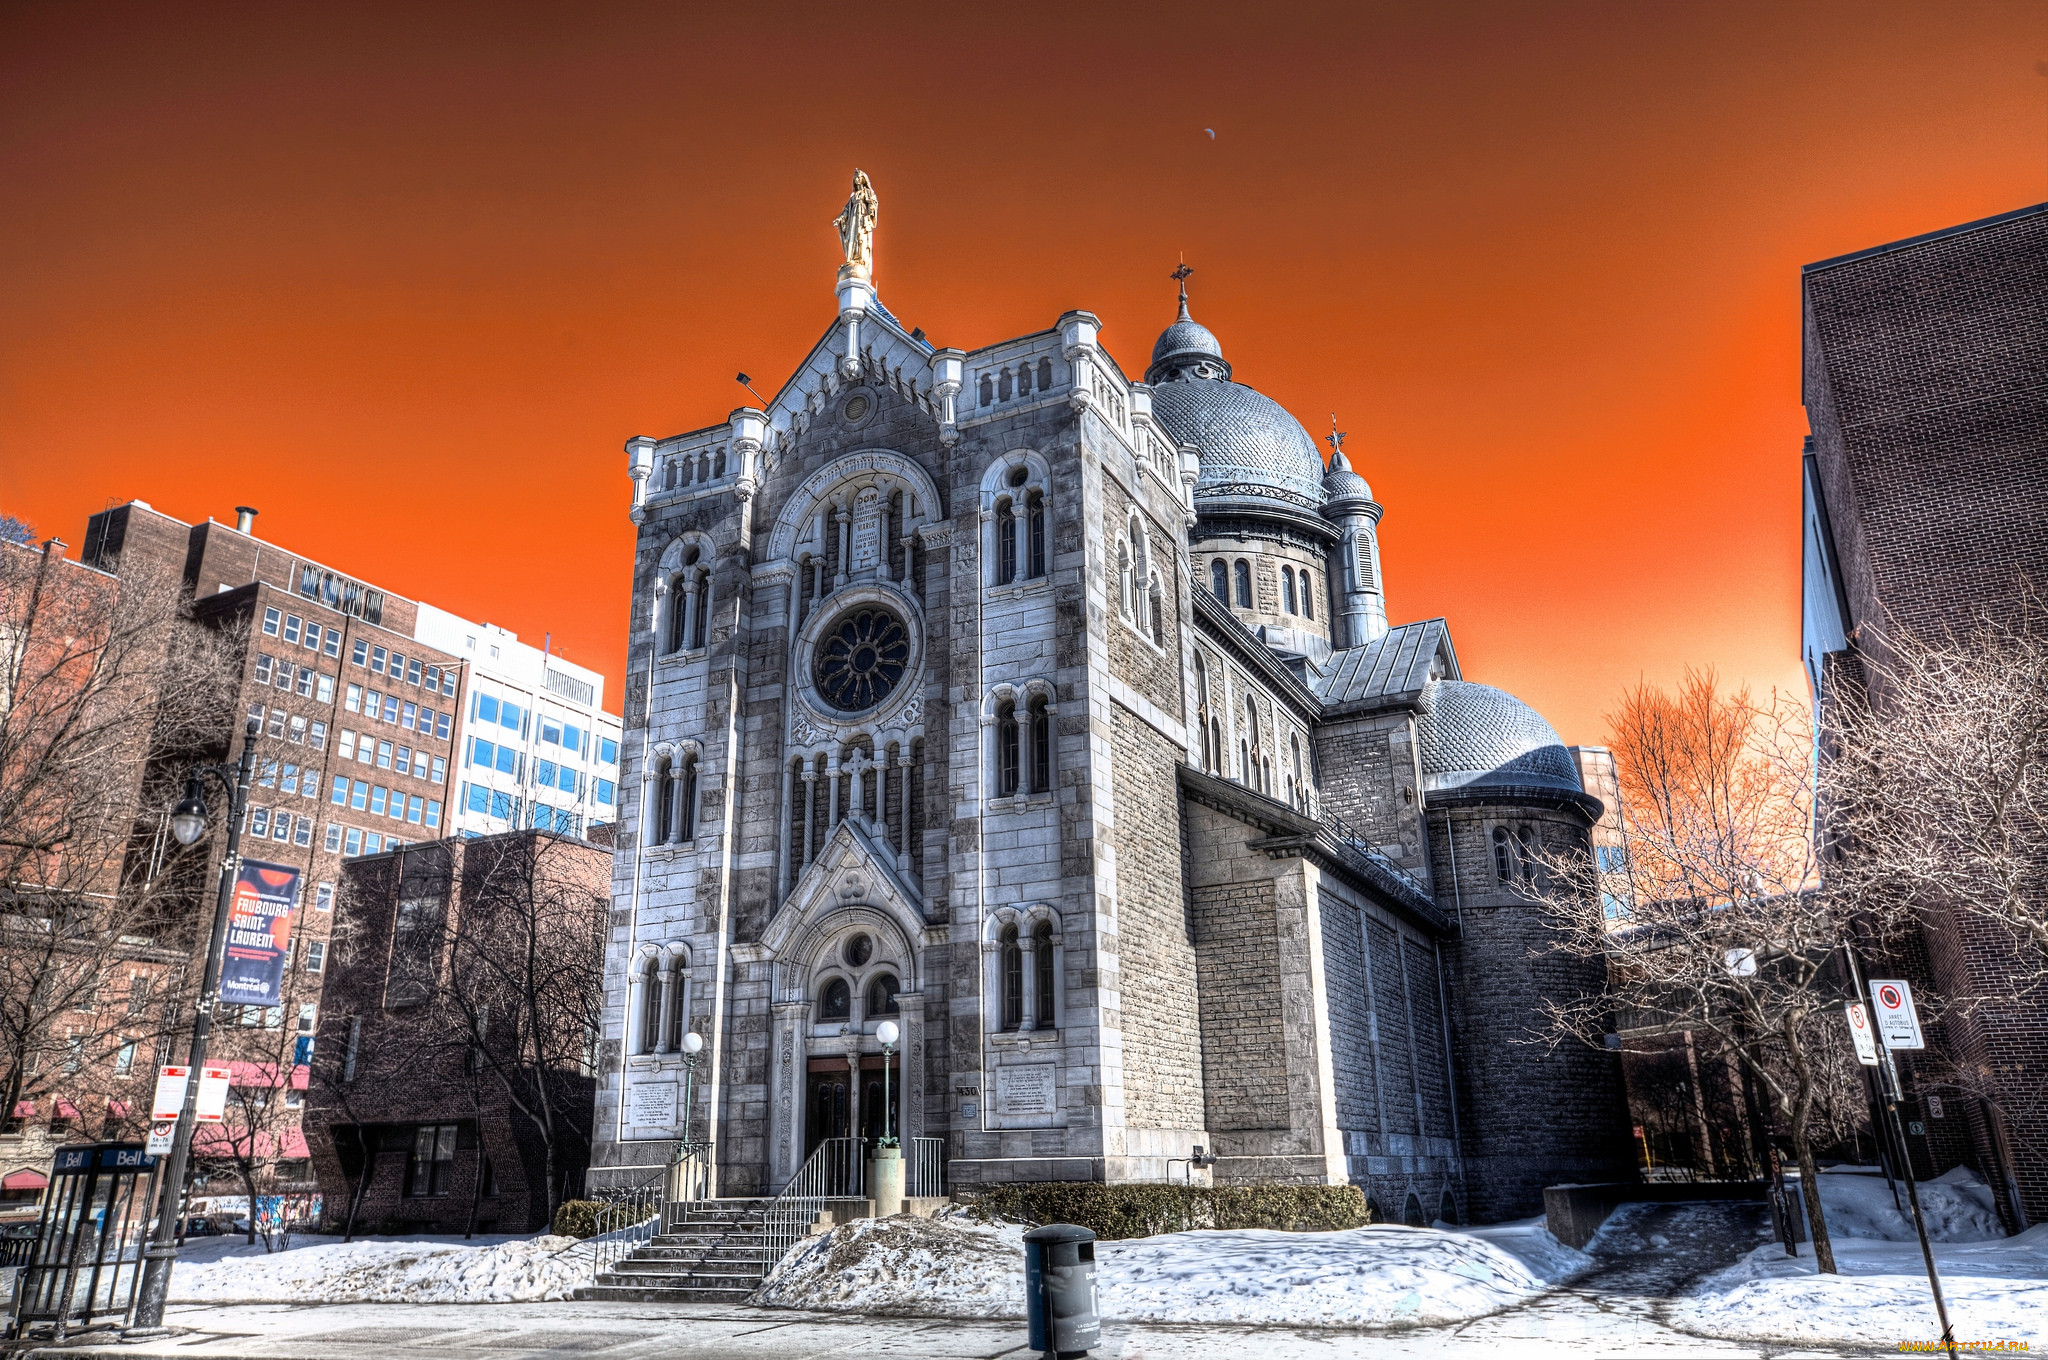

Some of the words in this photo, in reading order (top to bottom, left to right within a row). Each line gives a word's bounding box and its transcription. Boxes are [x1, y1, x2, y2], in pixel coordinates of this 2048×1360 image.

[858, 494, 877, 505] DOM
[236, 897, 290, 918] FAUBOURG
[230, 929, 276, 948] LAURENT
[227, 980, 260, 992] Montréal
[66, 1151, 84, 1168] Bell
[116, 1150, 142, 1166] Bell
